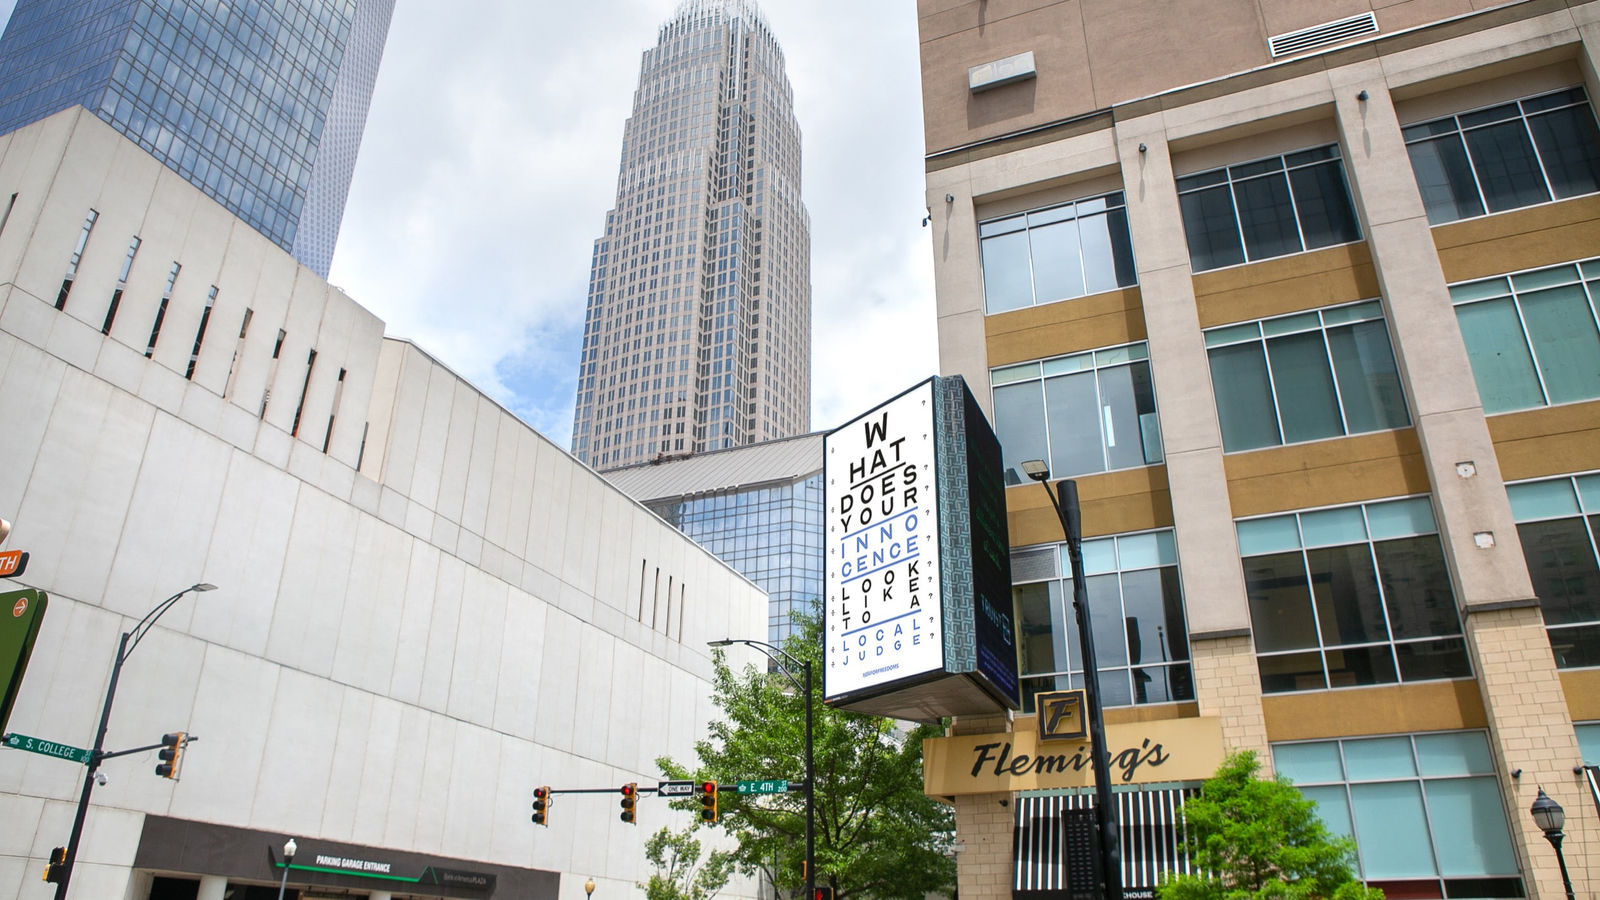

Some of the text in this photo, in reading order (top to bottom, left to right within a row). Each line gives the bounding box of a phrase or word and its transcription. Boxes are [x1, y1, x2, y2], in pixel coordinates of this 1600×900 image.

[864, 411, 888, 449] W
[850, 437, 906, 484] HAT
[841, 464, 917, 514] DOES
[840, 487, 917, 533] YOUR
[841, 514, 918, 559] INNO
[841, 535, 918, 577] CENCE
[842, 560, 919, 601] LOOK
[842, 577, 919, 616] LIKE
[842, 611, 871, 630] TO
[910, 594, 920, 609] A
[842, 634, 920, 666] JUDGE
[843, 618, 920, 652] LOCAL
[26, 738, 76, 758] S. COLLEGE
[750, 782, 774, 792] E. 4TH
[316, 855, 391, 873] PARKING GARAGE ENTRANCE
